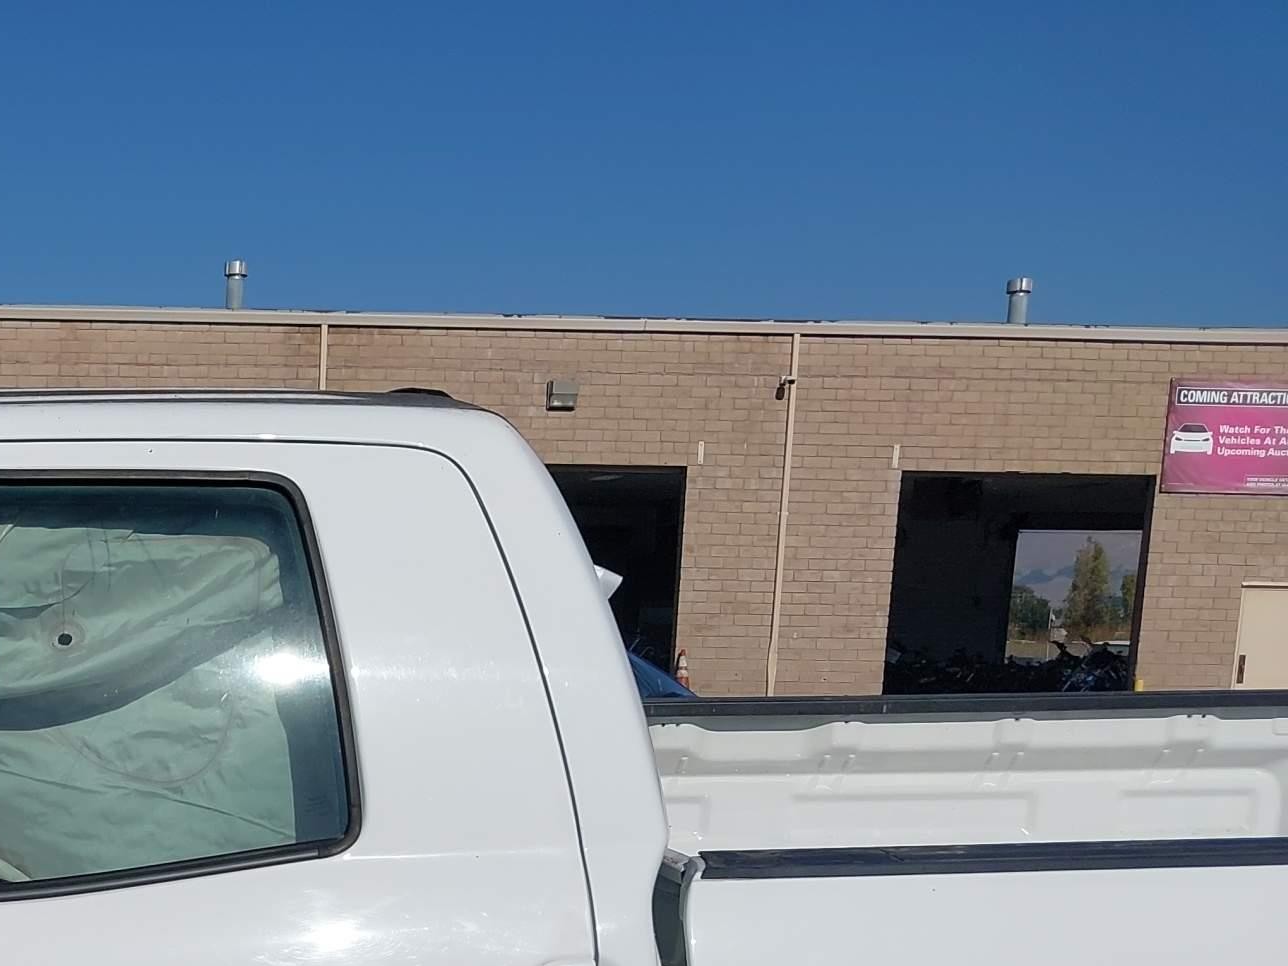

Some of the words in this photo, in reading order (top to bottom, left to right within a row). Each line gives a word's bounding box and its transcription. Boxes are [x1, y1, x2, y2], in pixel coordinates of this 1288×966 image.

[1180, 390, 1228, 403] COMING
[1220, 425, 1251, 434] Watch
[1254, 425, 1271, 434] For
[1219, 436, 1261, 445] Vehicles
[1264, 437, 1276, 445] At
[1279, 437, 1288, 445] A
[1217, 446, 1266, 458] Upcoming
